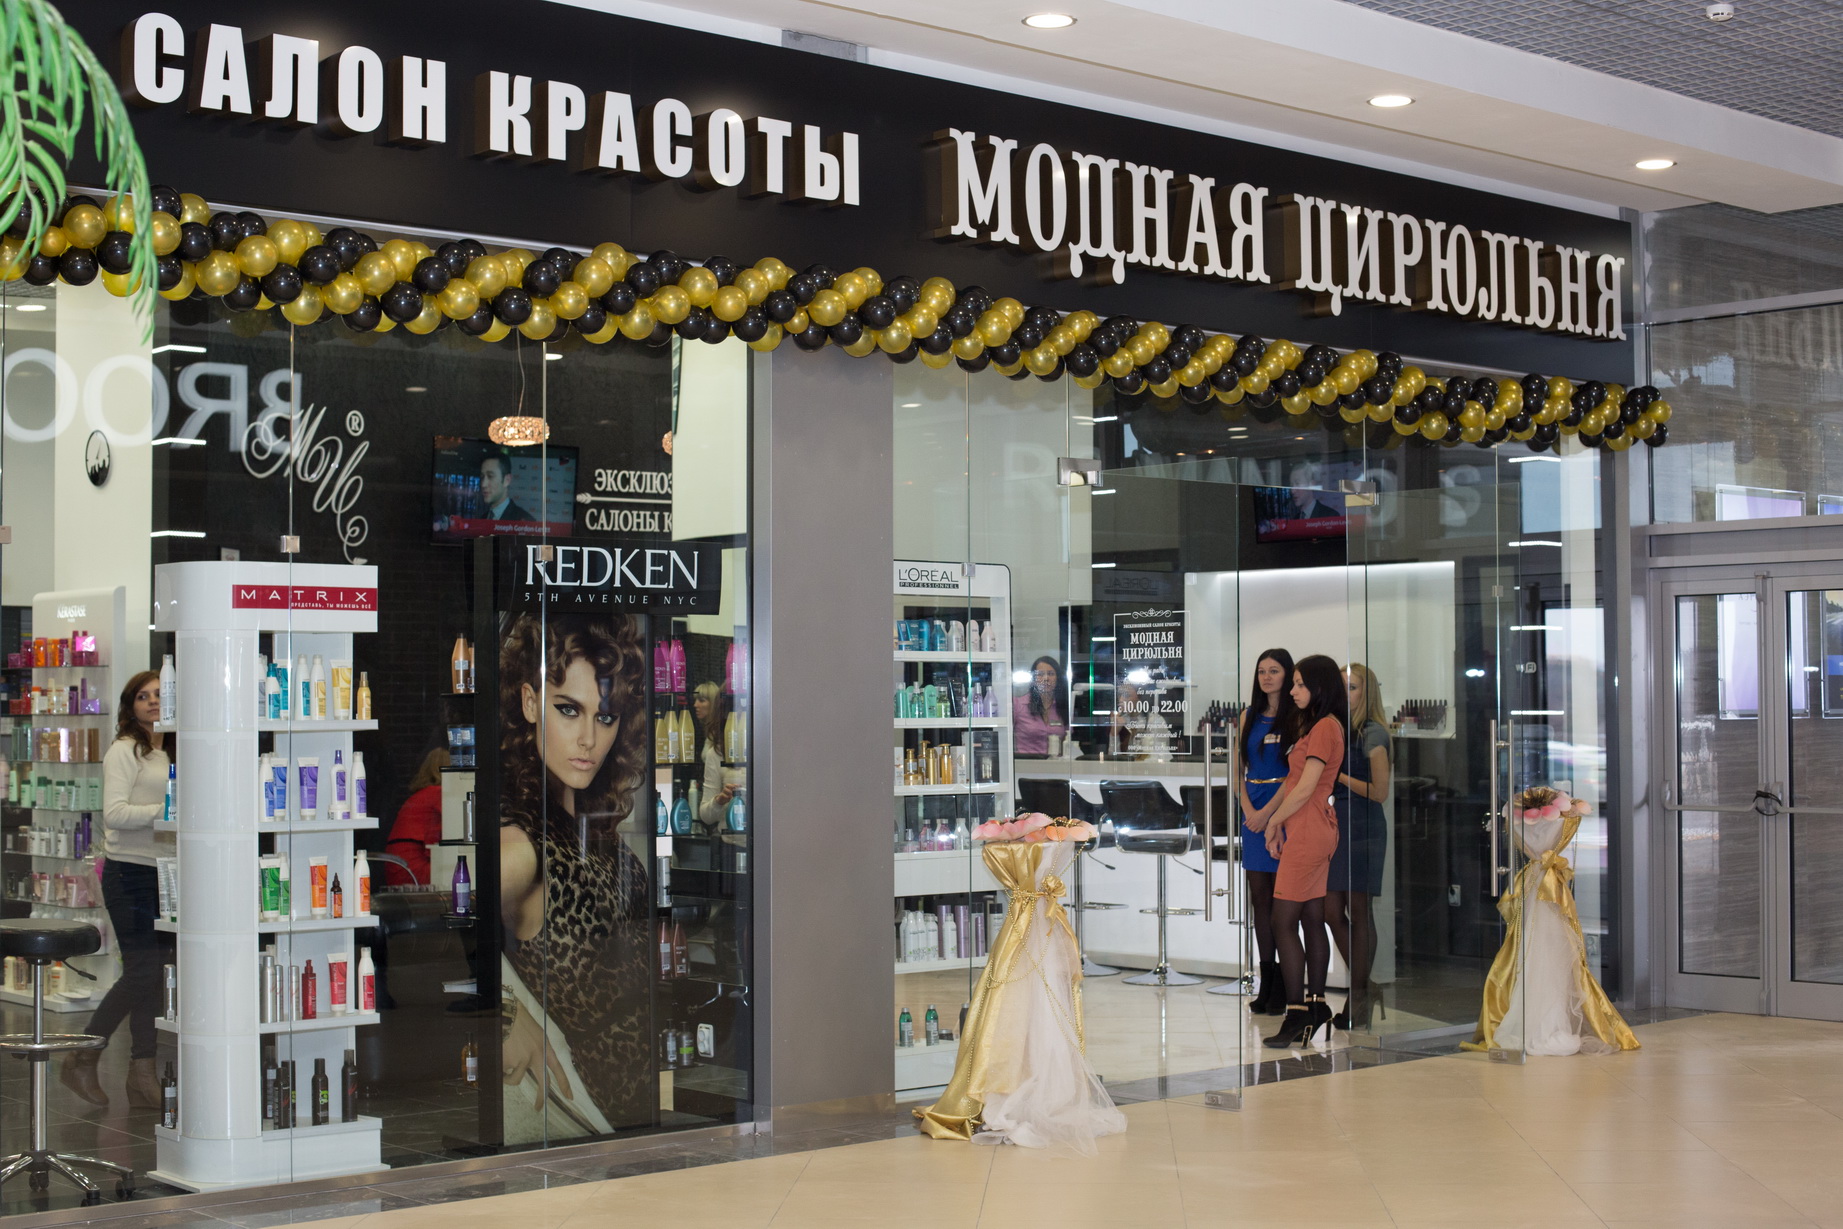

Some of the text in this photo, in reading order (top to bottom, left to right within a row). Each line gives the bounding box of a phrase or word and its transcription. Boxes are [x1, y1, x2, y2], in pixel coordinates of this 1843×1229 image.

[133, 12, 859, 206] САЛОН КРАСОТЫ
[949, 127, 1271, 285] МОДНАЯ
[1294, 193, 1627, 341] ЦИРЮЛЬНЯ
[585, 508, 661, 532] САЛОНЫ
[525, 545, 698, 589] REDKEN
[241, 590, 367, 602] MATRIX
[525, 593, 697, 605] 5TH AVENUE NYC
[1130, 631, 1174, 646] МОДНАЯ
[1122, 646, 1183, 662] ЦИРЮЛЬНЯ
[1123, 700, 1149, 713] 10.00
[1160, 699, 1188, 713] 22.00
